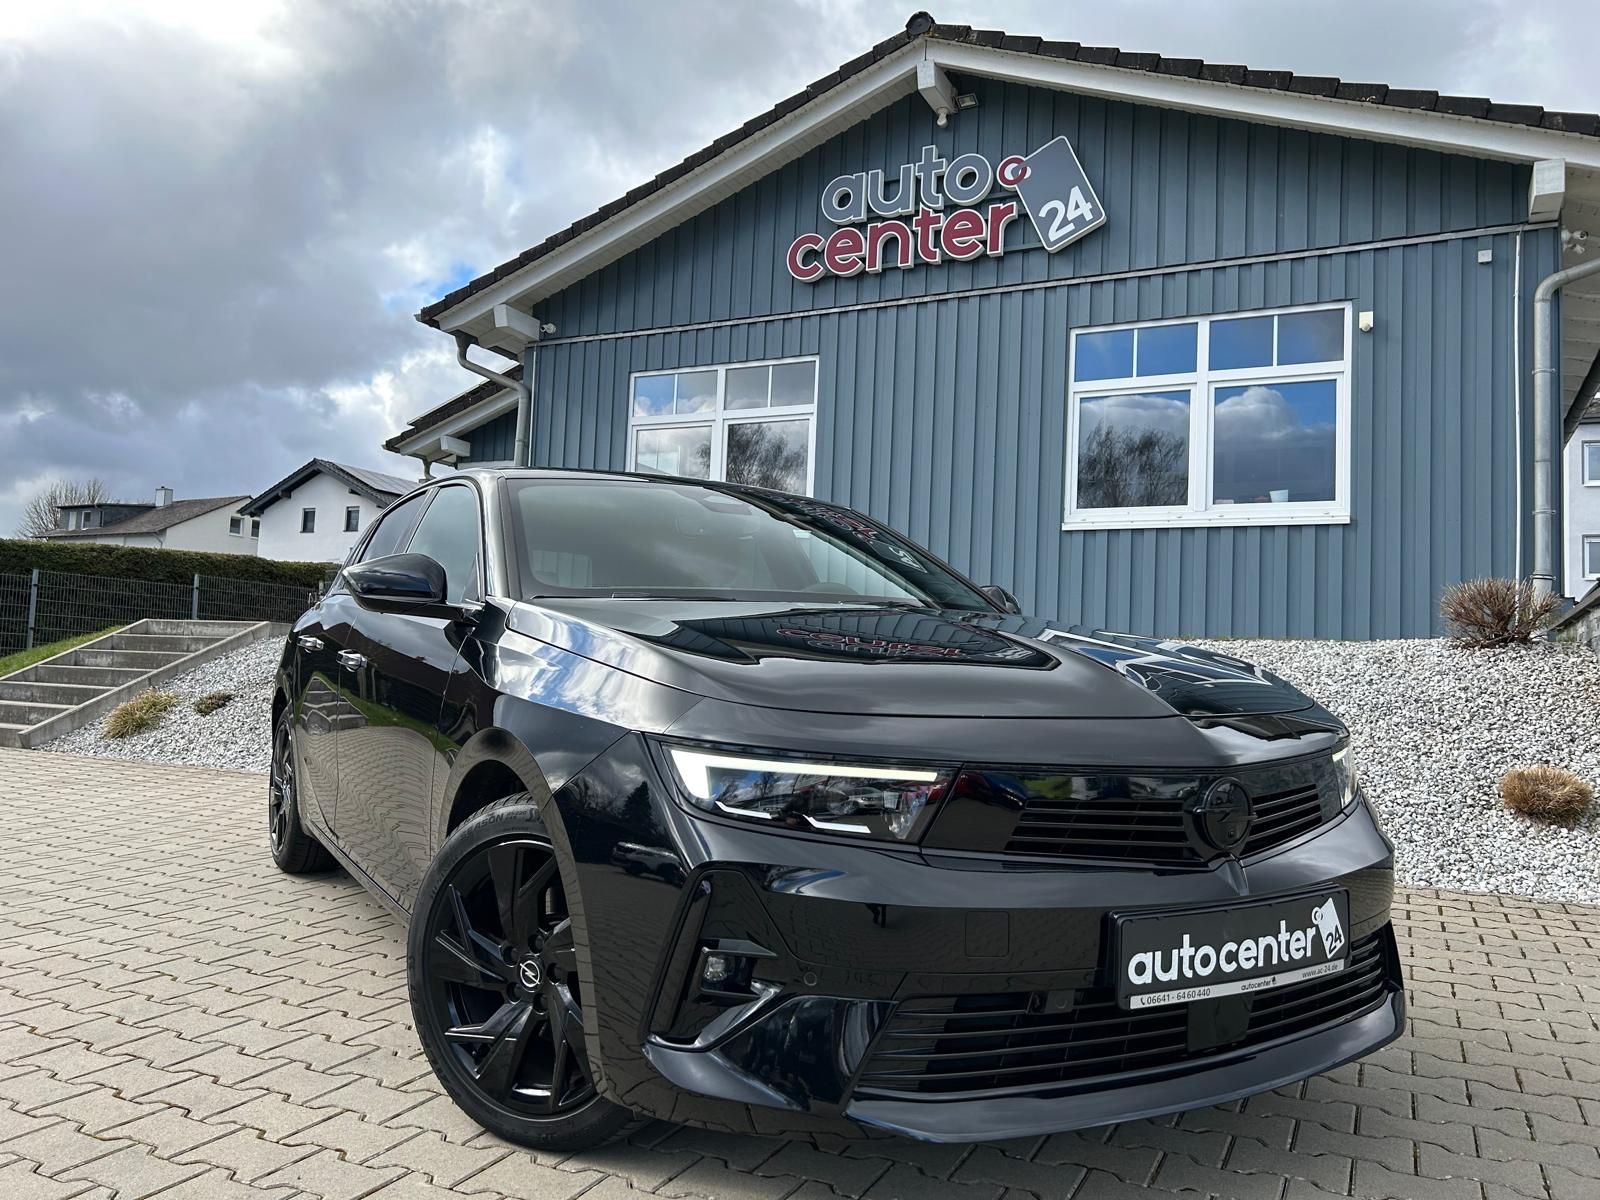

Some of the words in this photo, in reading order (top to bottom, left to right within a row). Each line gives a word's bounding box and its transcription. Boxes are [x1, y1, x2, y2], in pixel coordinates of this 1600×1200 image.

[821, 144, 994, 225] auto
[1038, 185, 1092, 242] 24
[787, 202, 1018, 283] center
[1325, 931, 1342, 954] 24
